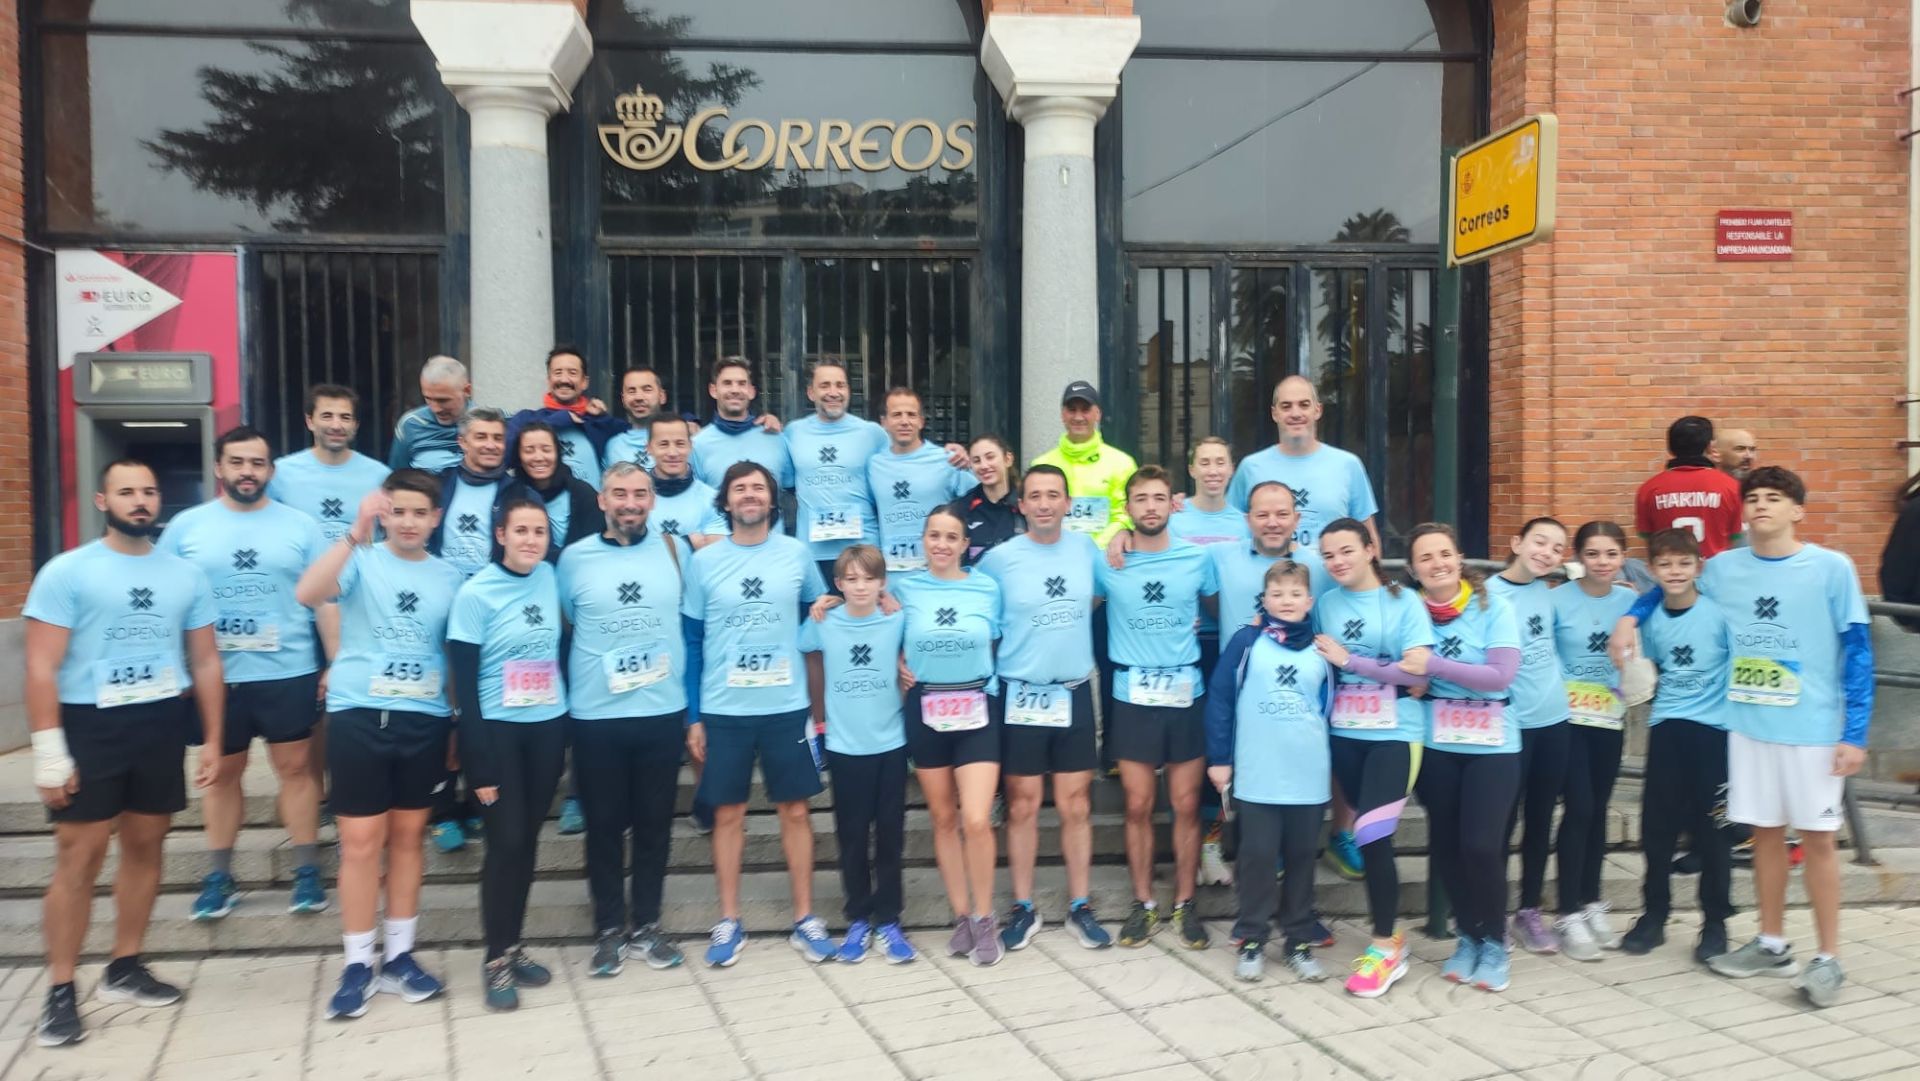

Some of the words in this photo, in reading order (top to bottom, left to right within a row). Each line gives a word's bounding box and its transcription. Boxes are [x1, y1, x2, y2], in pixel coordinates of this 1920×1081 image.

[683, 107, 975, 171] CORREOS
[1459, 204, 1510, 235] Correos
[1726, 231, 1773, 241] RESPONSABLE
[1717, 245, 1747, 255] EMPRESA
[102, 290, 152, 303] EURO
[141, 367, 187, 381] EURO
[1655, 487, 1721, 510] HAKIMI
[817, 512, 846, 527] 454
[889, 543, 919, 558] 471
[216, 617, 259, 636] 460
[382, 661, 424, 682] 459
[614, 652, 650, 676] 461
[735, 653, 774, 672] 467
[106, 663, 154, 688] 484
[1138, 673, 1174, 691] 477
[1734, 666, 1782, 689] 2208
[926, 697, 973, 718] 1327
[1015, 691, 1050, 709] 970
[1334, 694, 1380, 714] 1703
[1438, 708, 1491, 729] 1692
